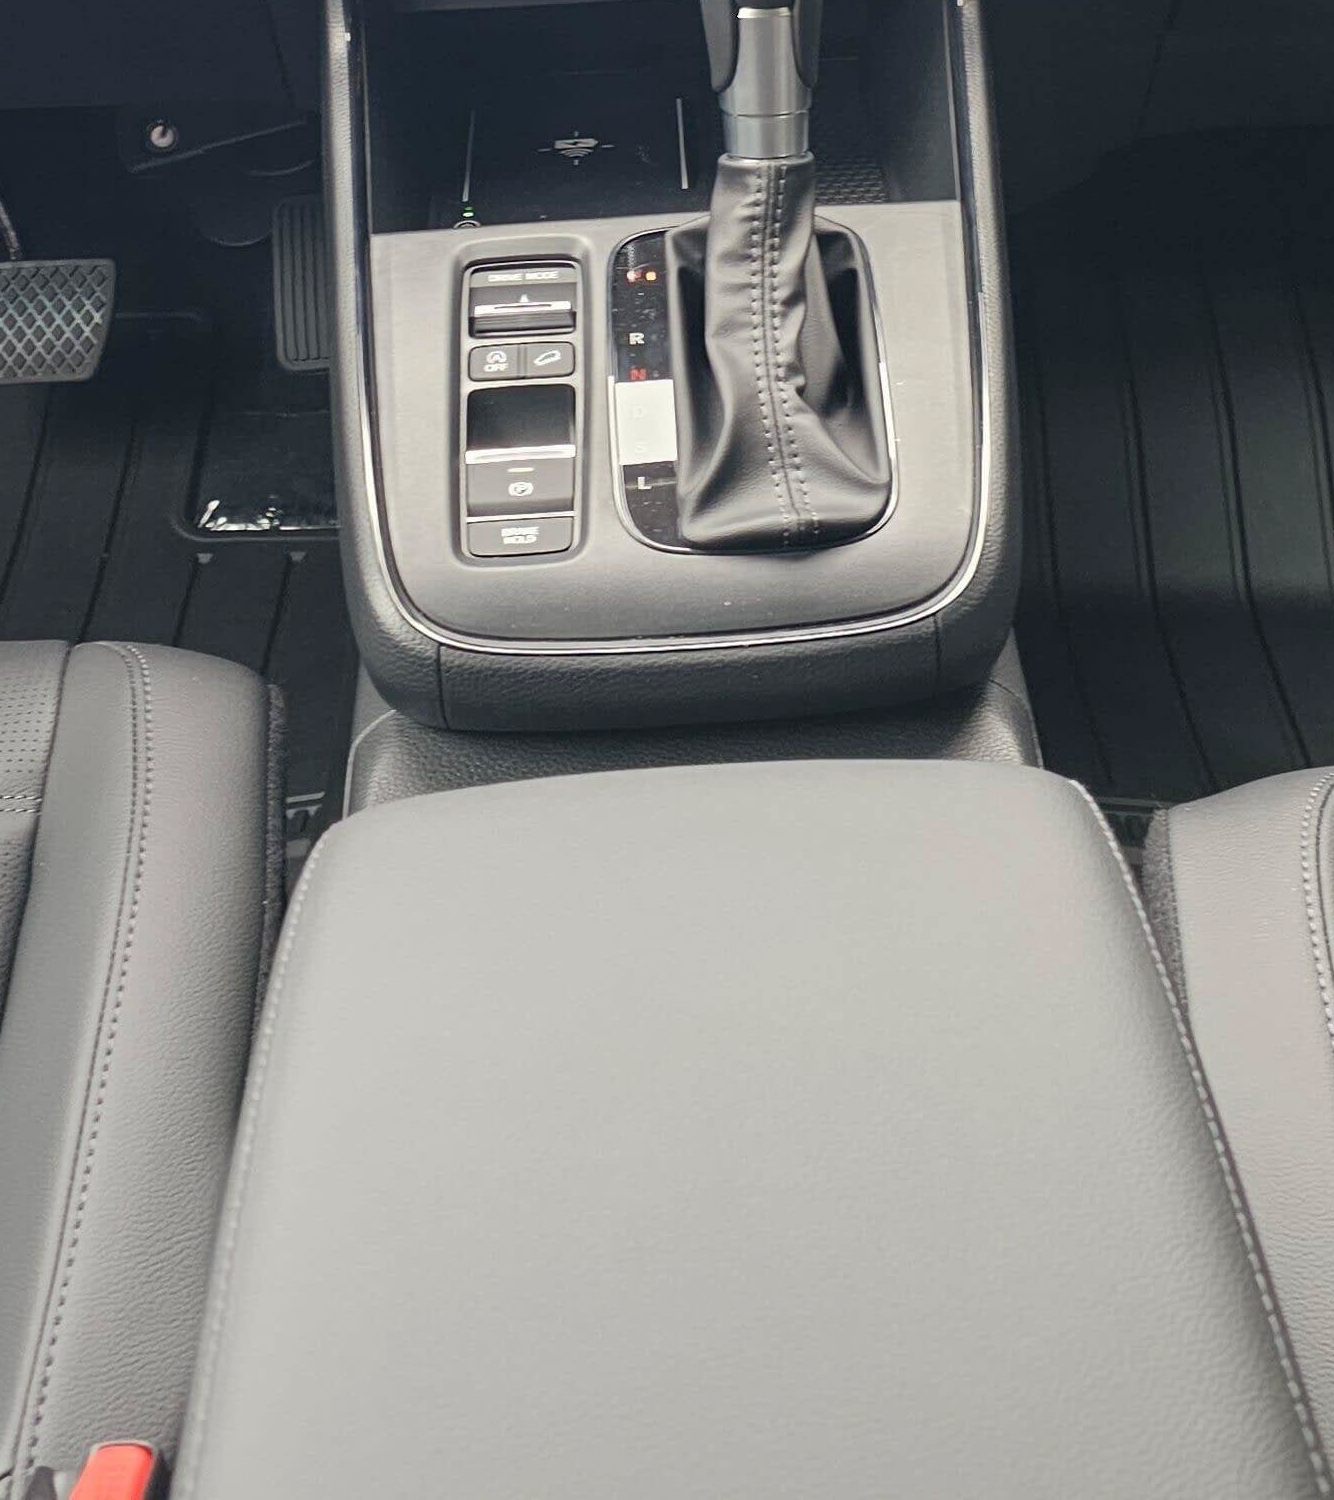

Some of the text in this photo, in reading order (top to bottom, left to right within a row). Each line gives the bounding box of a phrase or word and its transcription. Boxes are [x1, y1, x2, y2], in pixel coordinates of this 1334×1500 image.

[629, 332, 644, 346] R
[630, 366, 647, 382] N
[638, 476, 652, 490] L
